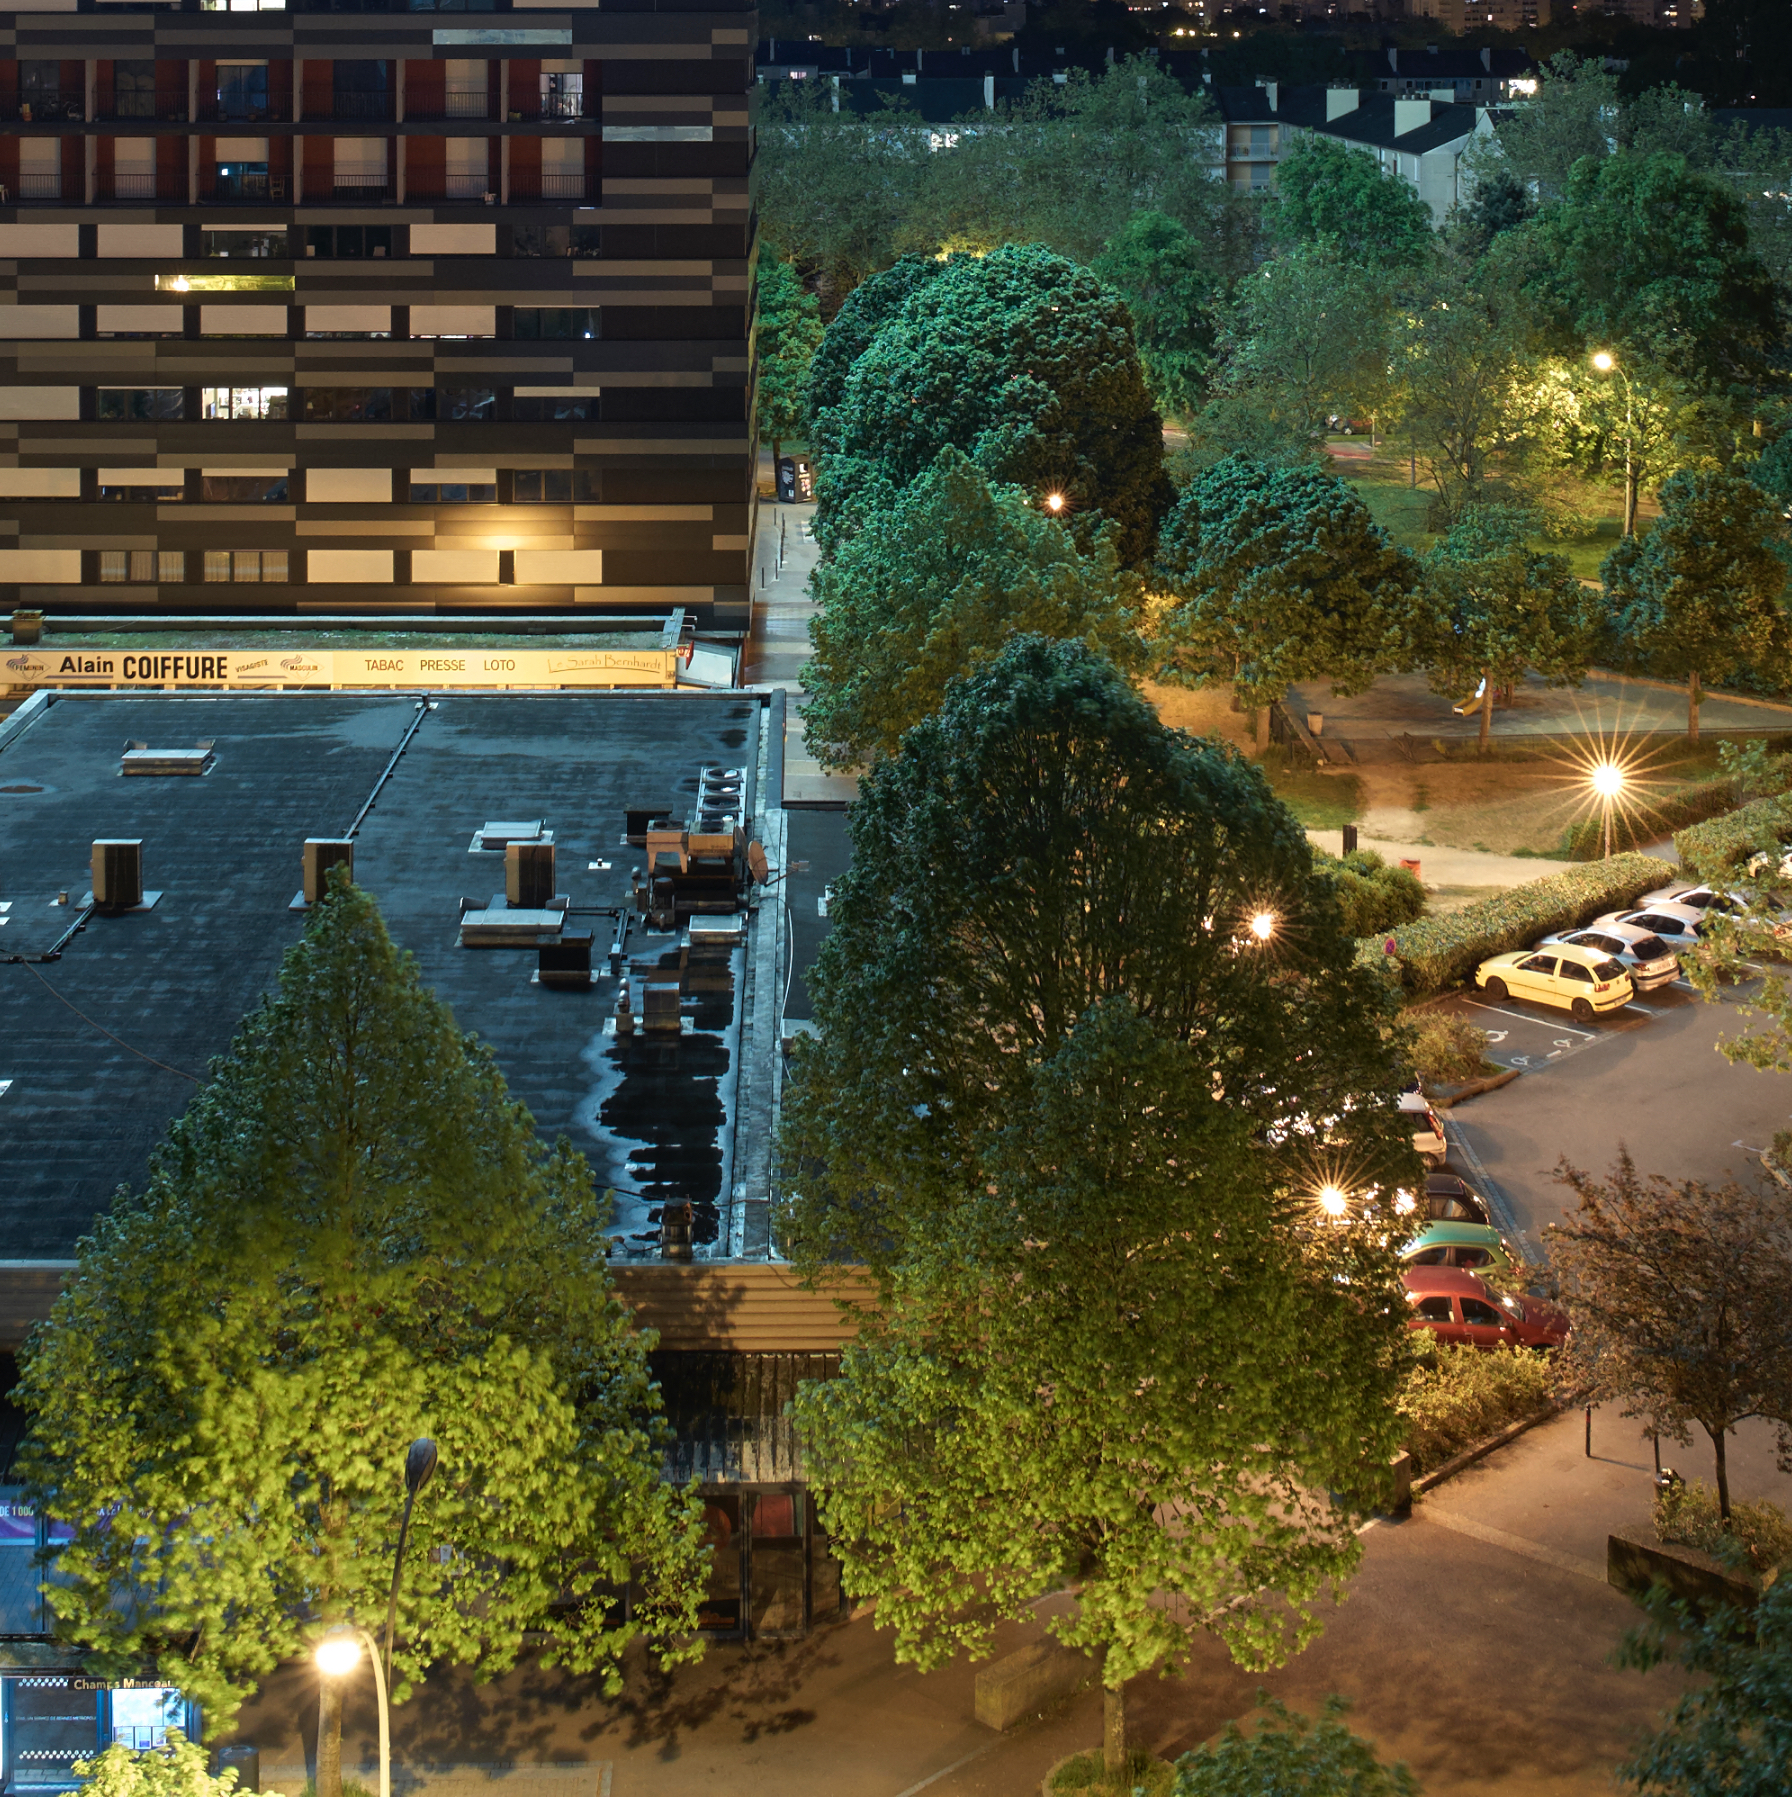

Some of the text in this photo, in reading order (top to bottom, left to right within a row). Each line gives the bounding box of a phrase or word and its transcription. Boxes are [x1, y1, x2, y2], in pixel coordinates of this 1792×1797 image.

[59, 656, 228, 679] Alain COIFFURE
[235, 659, 269, 673] VISAGISTE
[365, 659, 515, 671] TABAC PRESSE LOTO
[547, 654, 662, 673] Le Sarah Bernhardt
[0, 1506, 9, 1517] DE
